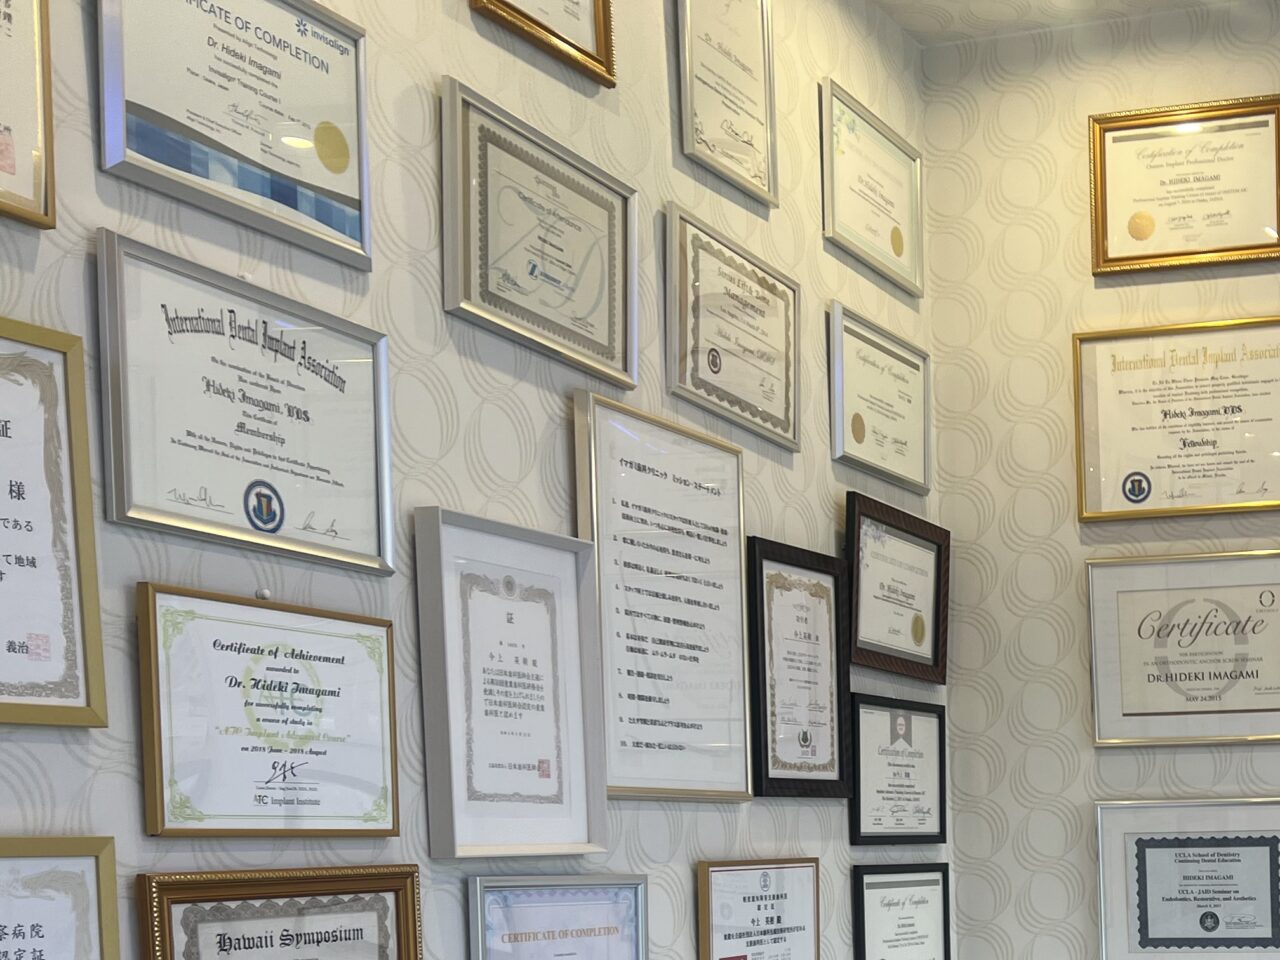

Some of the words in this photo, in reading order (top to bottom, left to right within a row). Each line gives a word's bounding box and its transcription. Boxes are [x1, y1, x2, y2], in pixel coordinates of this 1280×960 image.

[235, 17, 251, 33] OF
[255, 26, 330, 75] COMPLETION
[311, 27, 350, 57] invisalign
[207, 36, 219, 50] Dr.
[222, 43, 247, 63] Hideki
[249, 55, 281, 80] Imagami
[161, 303, 225, 344] International
[228, 308, 258, 350] Dental
[262, 319, 295, 362] Implant
[298, 339, 346, 394] Association
[1111, 353, 1165, 374] International
[1170, 348, 1199, 372] Dental
[1202, 346, 1237, 369] Implant
[8, 480, 26, 501] 様
[1137, 608, 1268, 648] Certificate
[213, 638, 265, 657] Certificate
[268, 647, 280, 660] of
[284, 649, 345, 665] Achievement
[225, 675, 246, 690] Dr.
[250, 678, 288, 694] Hideki
[292, 682, 341, 698] Imagami
[1208, 669, 1259, 681] IMAGAMI
[216, 930, 274, 955] Hawaii
[279, 926, 364, 949] Symposium
[501, 930, 557, 944] CERTIFICATE
[558, 929, 569, 940] OF
[570, 926, 620, 939] COMPLETION
